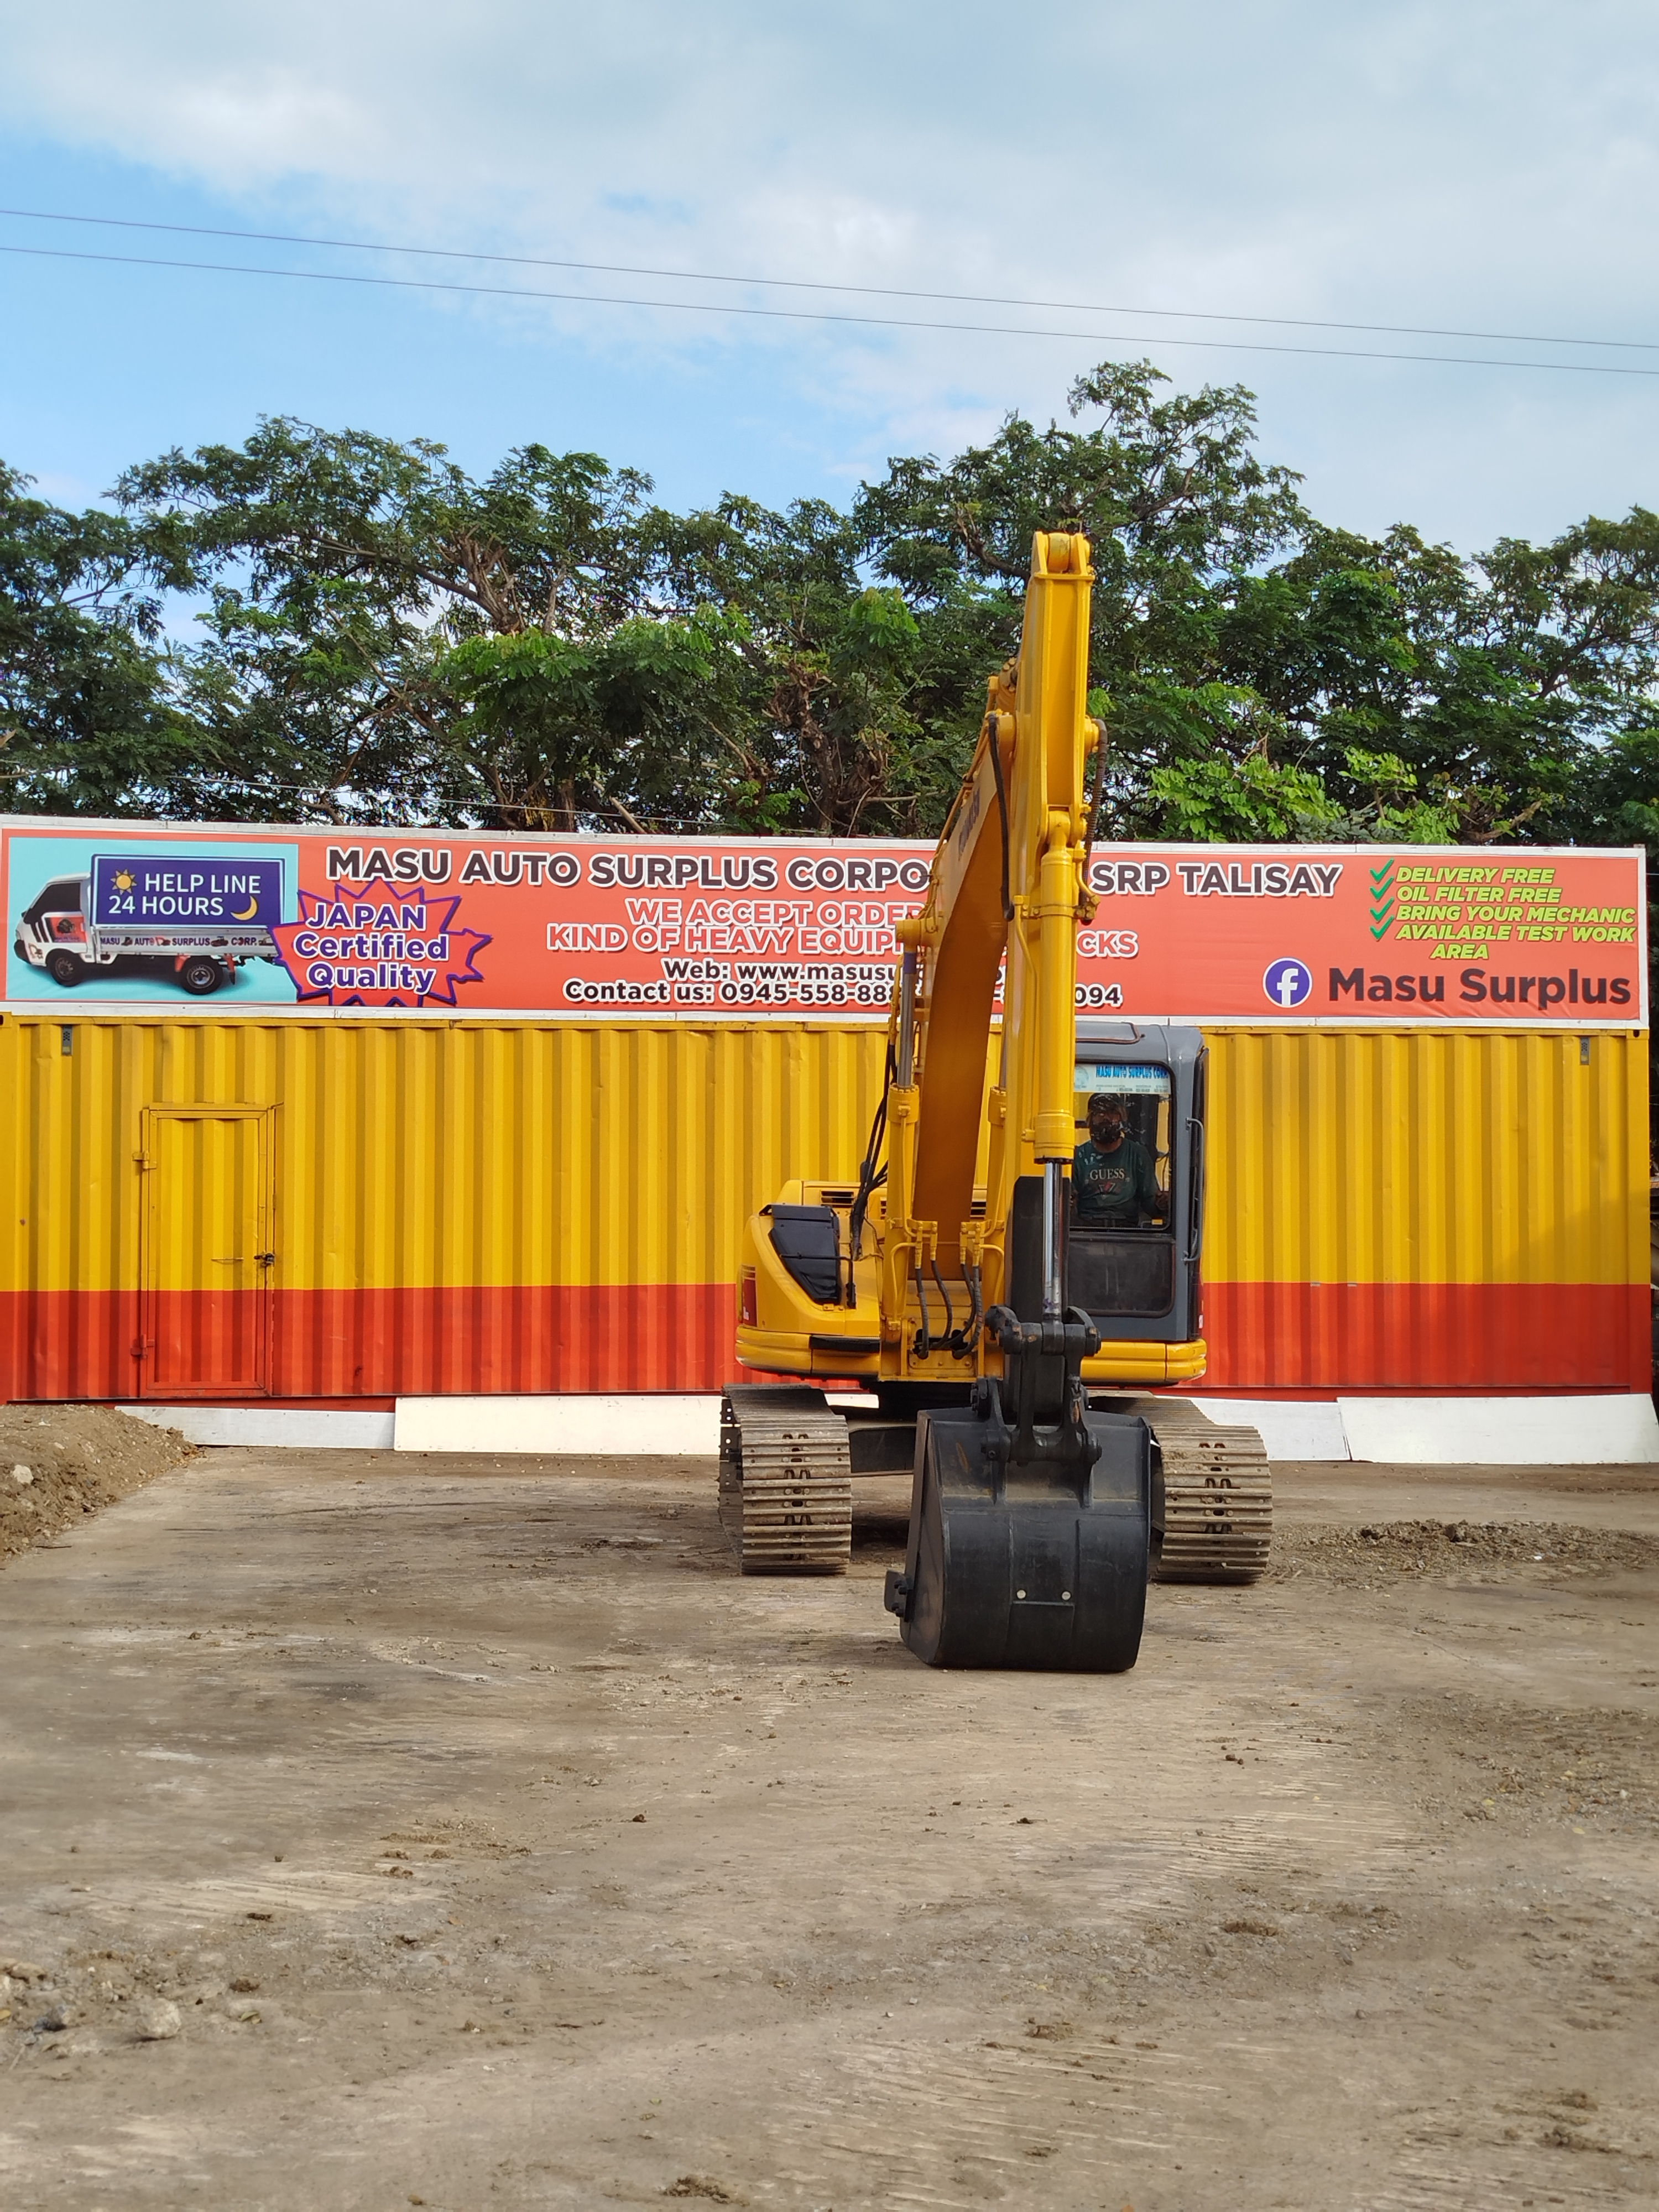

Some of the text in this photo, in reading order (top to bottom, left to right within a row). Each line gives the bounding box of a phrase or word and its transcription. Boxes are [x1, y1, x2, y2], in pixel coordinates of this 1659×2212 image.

[326, 846, 1344, 897] MASU AUTO SURPLUS CORPO SRP TALISAY
[1396, 867, 1556, 885] DELIVERY FREE
[144, 873, 261, 894] HELP LINE
[1396, 886, 1562, 903] OIL FILTER FREE
[108, 895, 224, 916] 24 HOURS
[305, 902, 427, 932] JAPAN
[625, 898, 682, 926] WE
[688, 899, 813, 928] ACCEPT
[1396, 905, 1635, 924] BRING YOUR MECHANIC
[100, 937, 120, 946] MASU
[172, 937, 210, 946] SURPLUS
[547, 922, 1139, 958] KIND OF HEAVY EQUIP CKS
[1396, 925, 1636, 943] AVAILABLE TEST WORK
[292, 931, 449, 963] Certified
[1430, 943, 1489, 960] AREA
[307, 961, 436, 995] Quality
[661, 957, 895, 983] Web: www.masusu
[563, 977, 670, 1004] Contact
[675, 982, 713, 1005] us:
[1075, 983, 1123, 1008] 094
[1329, 967, 1631, 1011] Masu Surplus
[1089, 1168, 1125, 1180] GUESS
